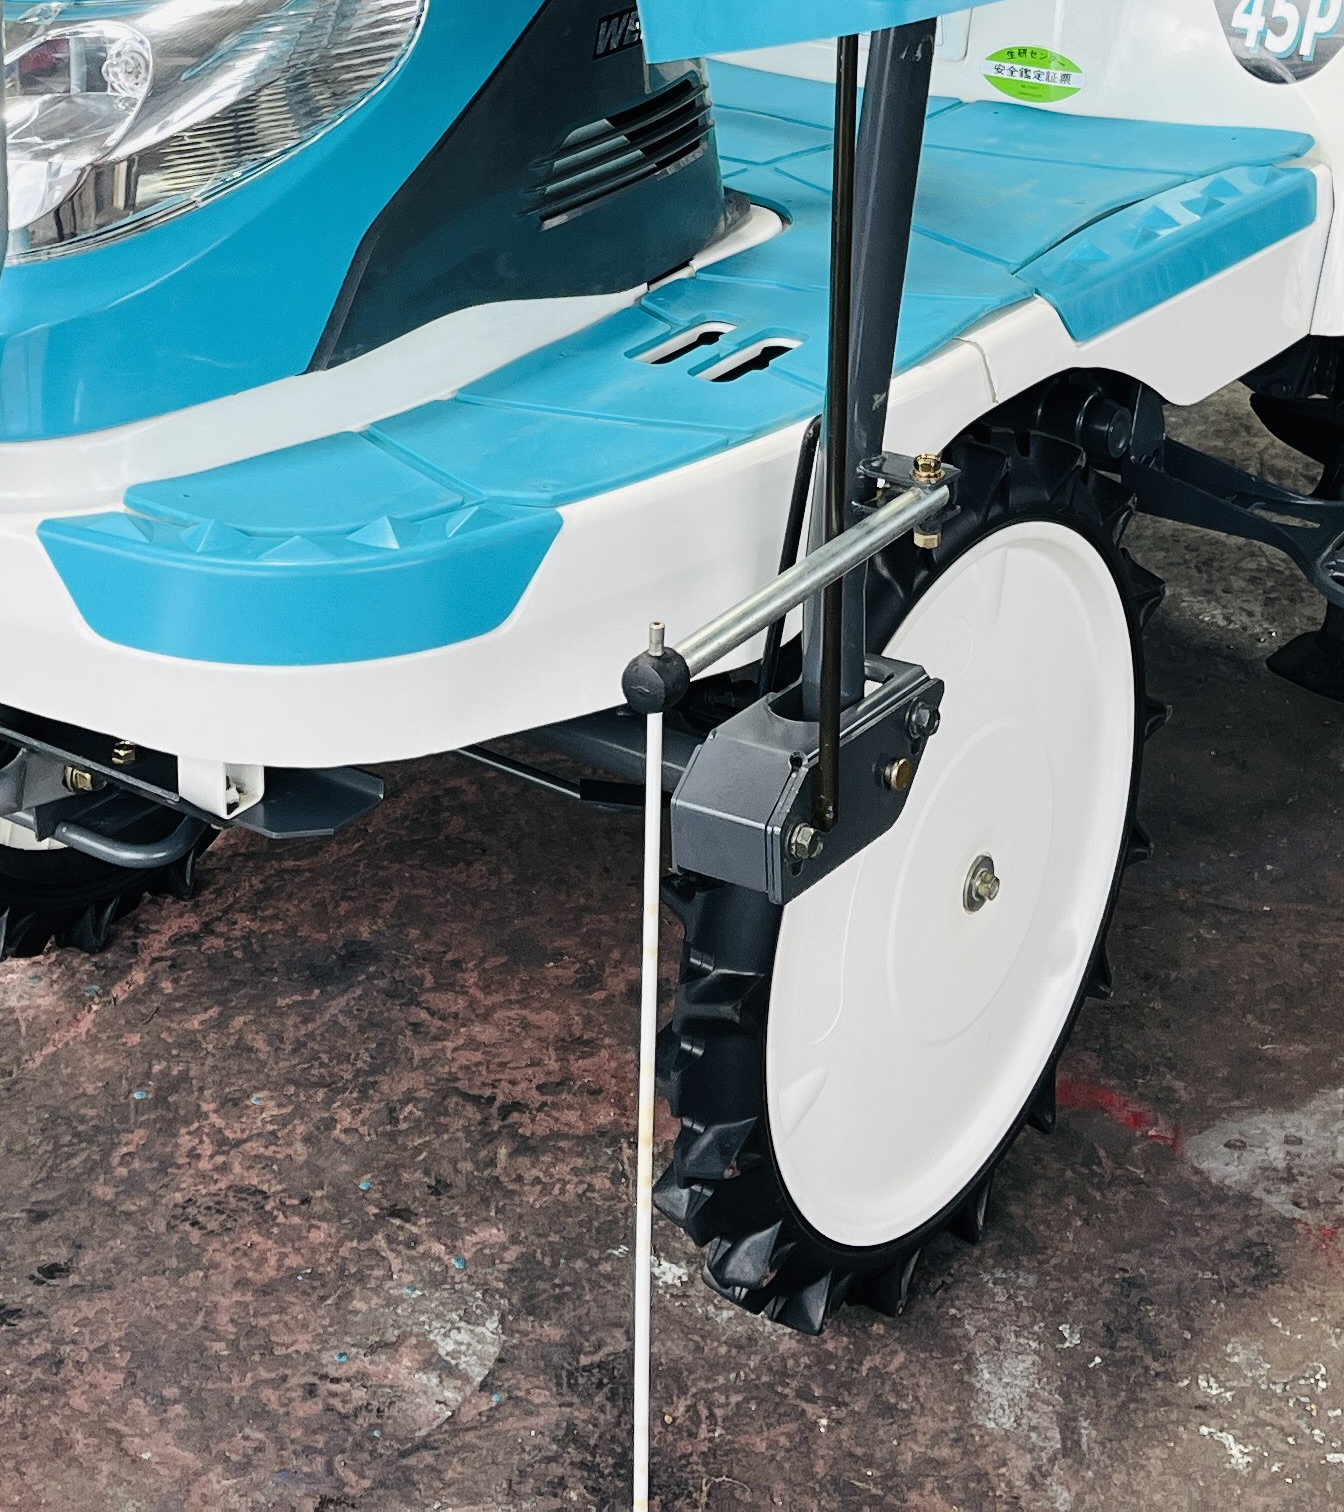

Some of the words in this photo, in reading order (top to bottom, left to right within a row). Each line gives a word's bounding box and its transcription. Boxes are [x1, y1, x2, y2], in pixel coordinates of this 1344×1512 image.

[993, 63, 1073, 85] 安全鑑定証票
